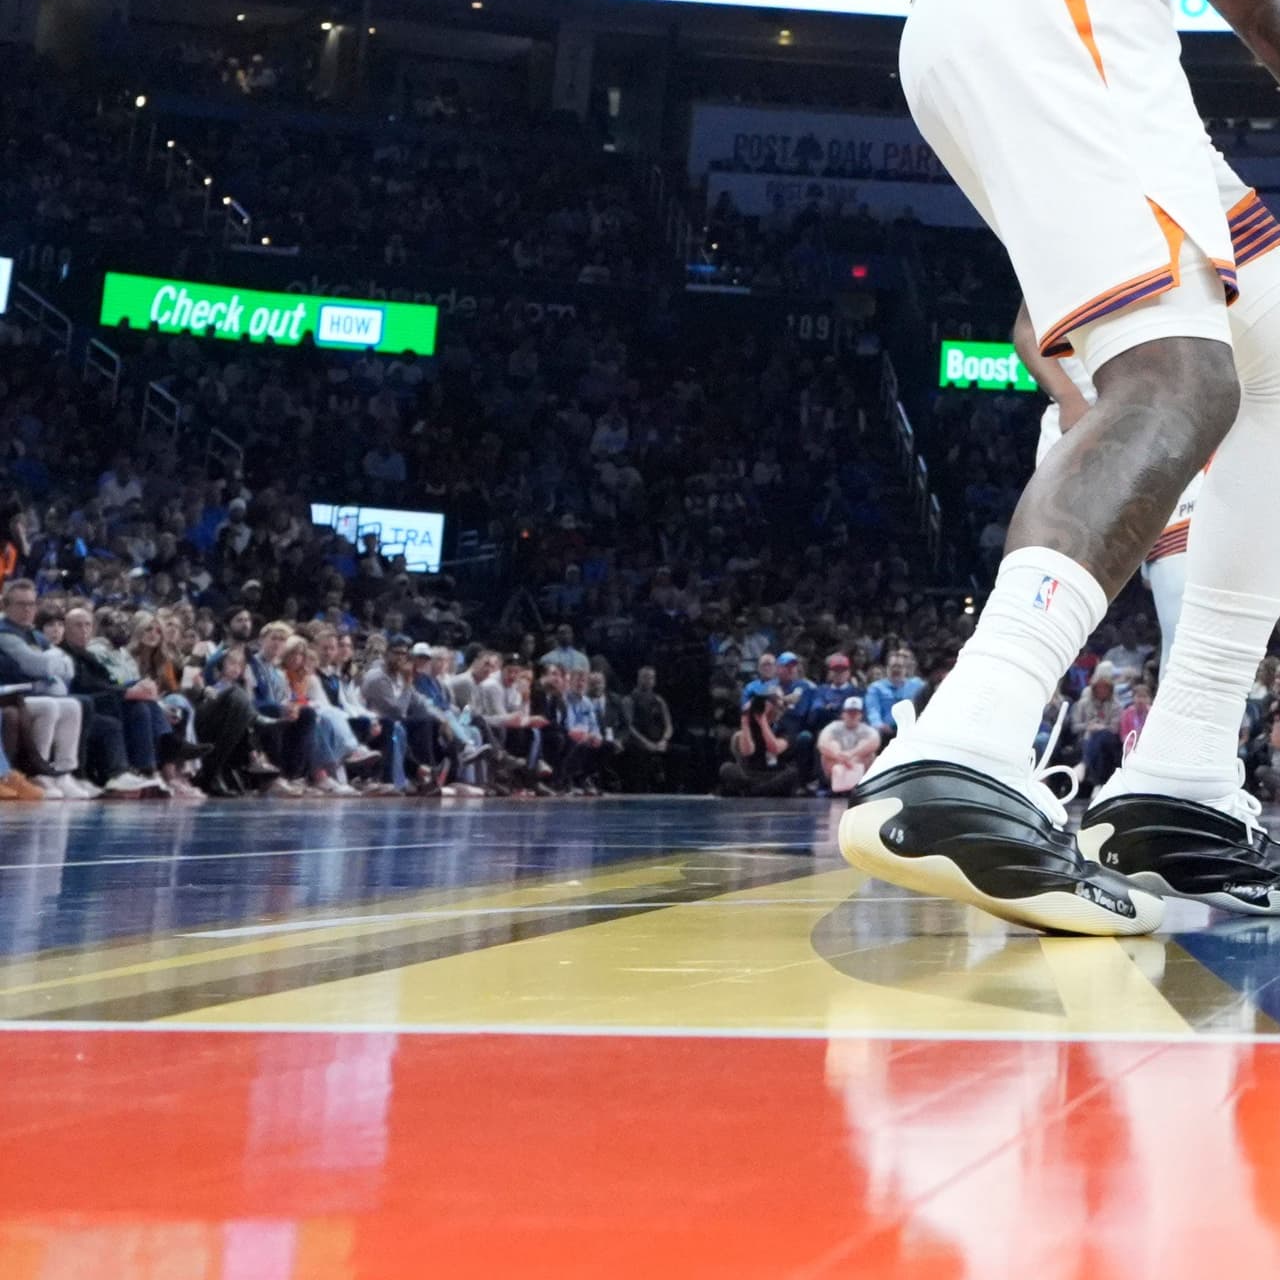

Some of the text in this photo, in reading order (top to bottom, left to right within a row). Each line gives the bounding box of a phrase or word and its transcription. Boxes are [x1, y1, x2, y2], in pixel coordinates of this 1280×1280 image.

[884, 144, 941, 172] PAR
[149, 284, 245, 333] Check
[248, 301, 306, 340] out
[329, 314, 372, 336] HOW
[946, 350, 1019, 382] Boost
